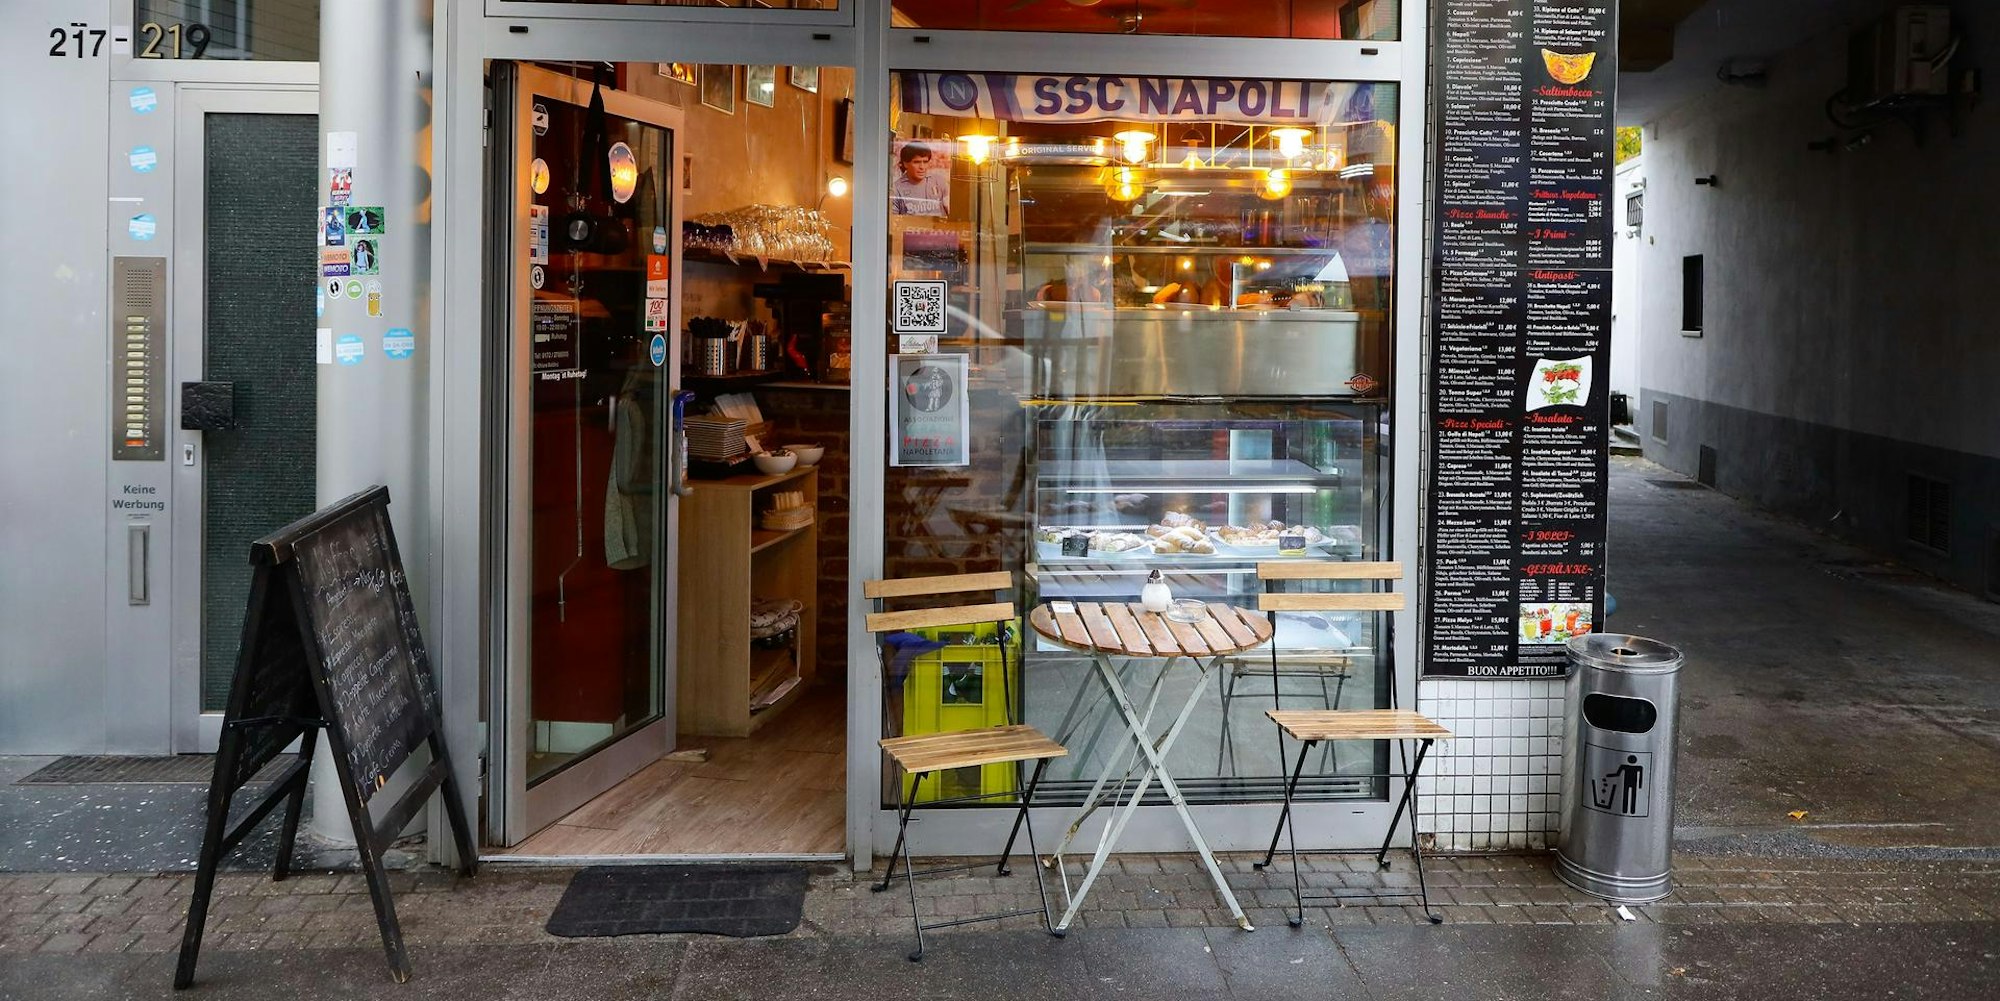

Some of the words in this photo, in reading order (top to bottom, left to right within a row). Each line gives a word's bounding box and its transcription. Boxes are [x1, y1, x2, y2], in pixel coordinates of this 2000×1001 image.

[49, 28, 106, 58] 217
[139, 22, 210, 59] 219
[1539, 85, 1592, 97] Saltimbocca
[1034, 76, 1125, 115] SSC
[1138, 78, 1310, 118] NAPOLI
[1022, 146, 1064, 155] ORIGINAL
[1534, 270, 1575, 281] Antipasti
[542, 373, 560, 381] Montag
[1532, 412, 1574, 423] Insalata
[1470, 419, 1504, 430] Speciali
[124, 485, 156, 494] Keine
[113, 500, 165, 511] Werbung
[1468, 666, 1498, 675] BUON
[1499, 666, 1557, 676] APPETITO!!!
